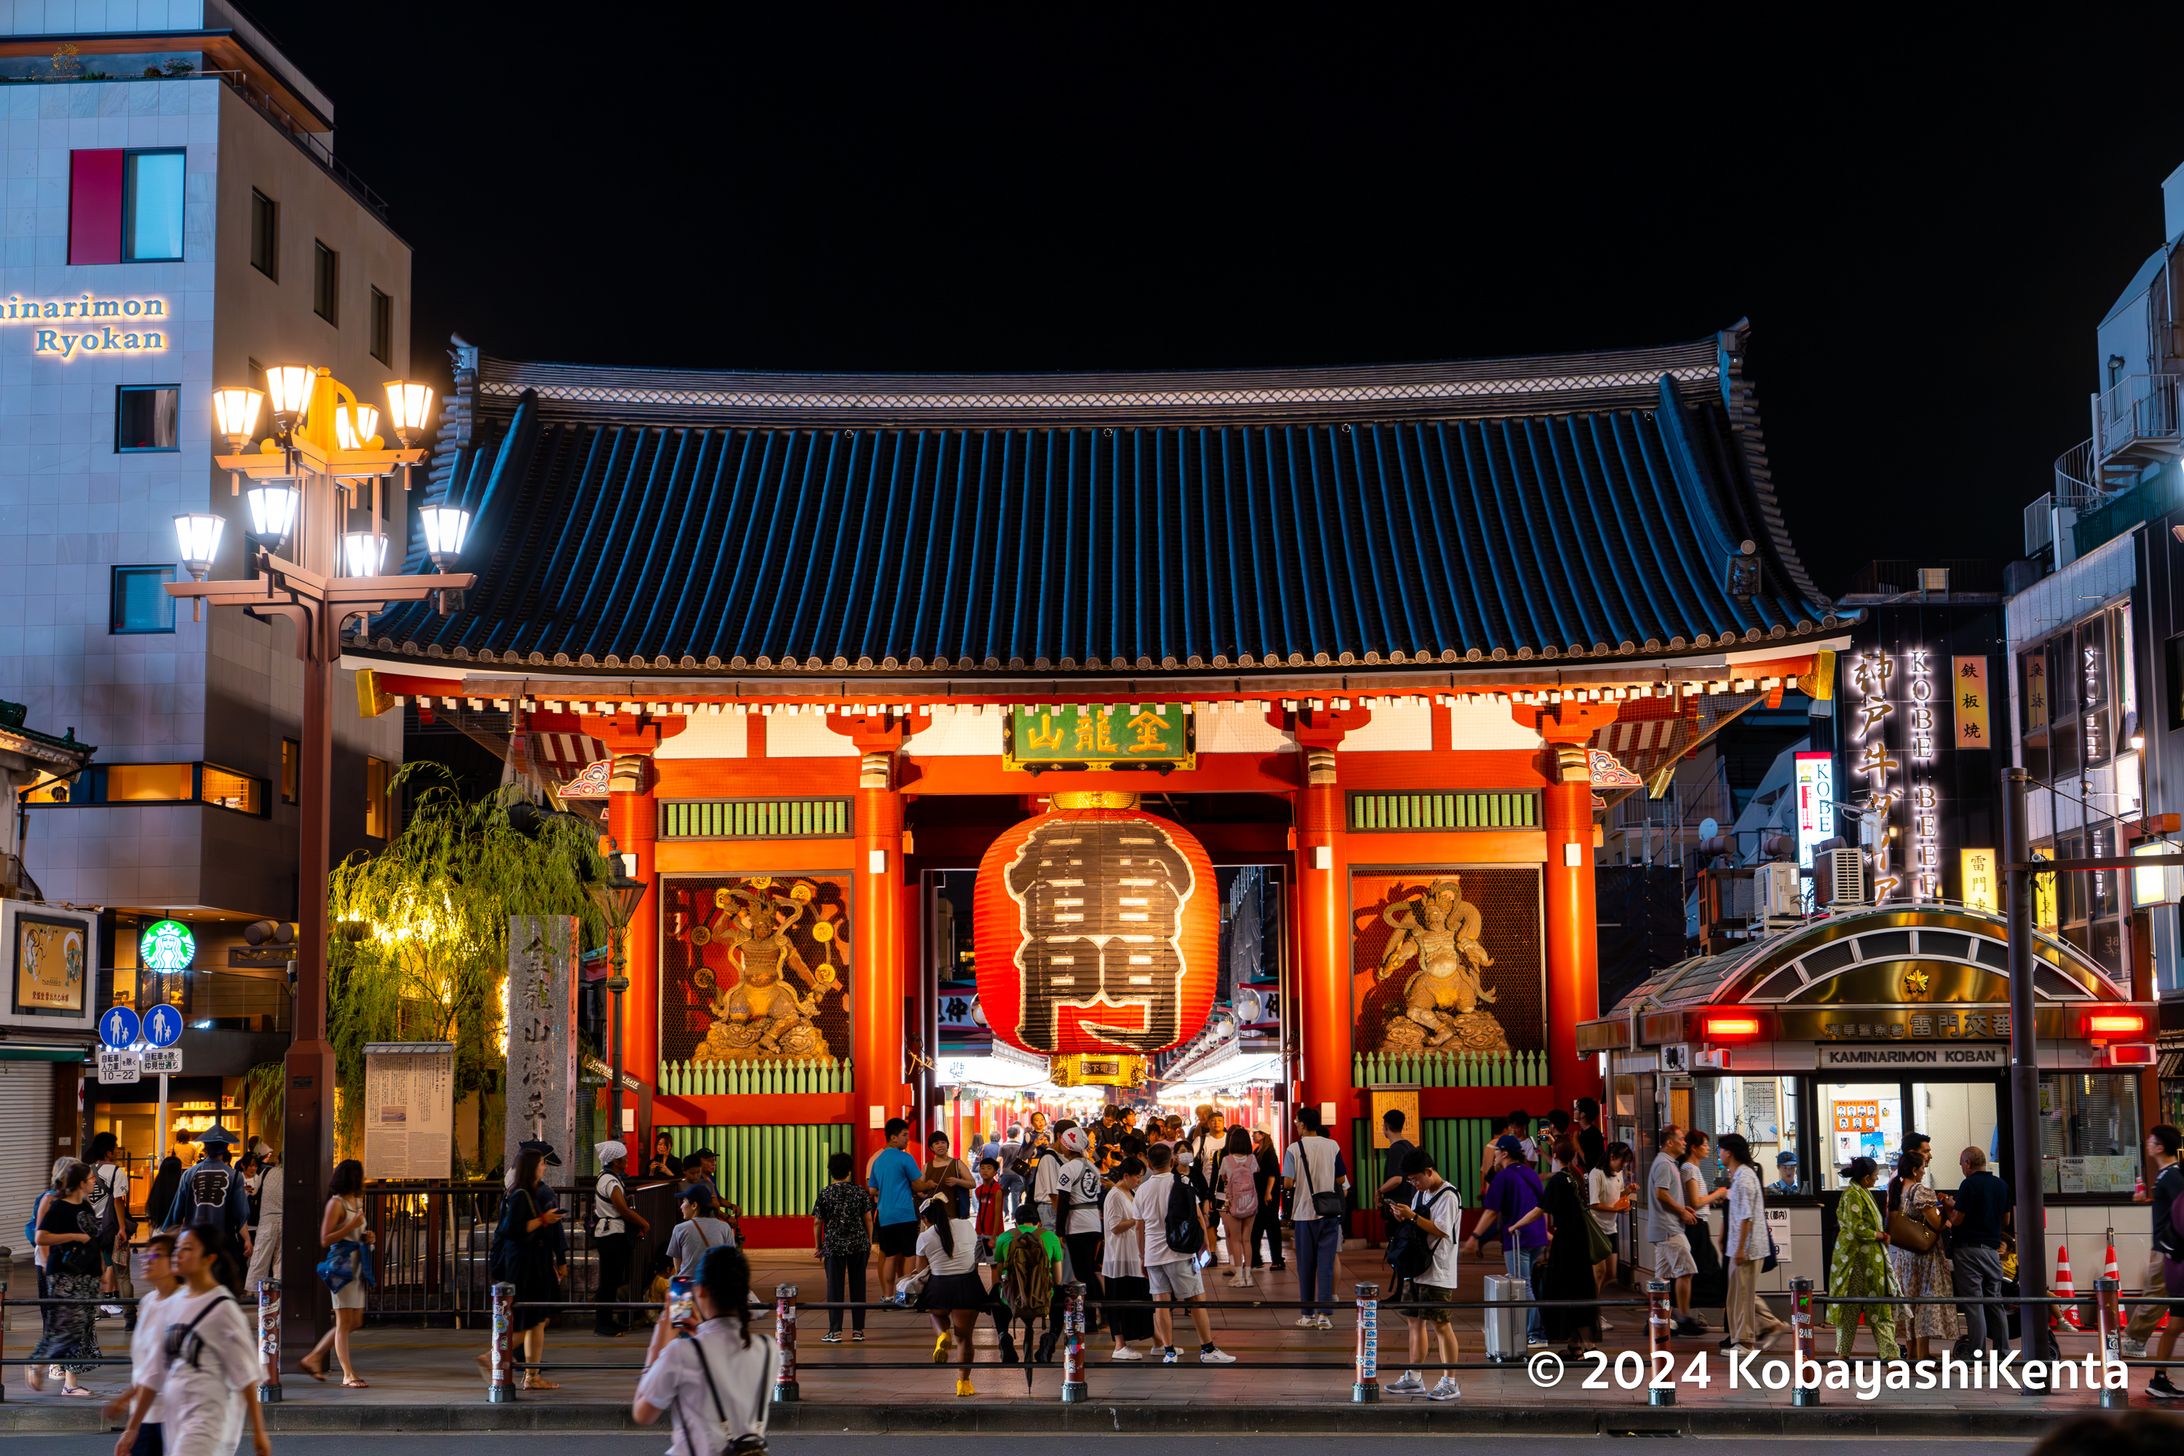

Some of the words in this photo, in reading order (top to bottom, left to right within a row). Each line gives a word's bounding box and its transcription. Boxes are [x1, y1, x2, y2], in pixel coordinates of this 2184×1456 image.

[35, 327, 163, 358] Ryokan
[1910, 651, 1934, 759] KOBE
[1960, 662, 1982, 739] 鉄板焼
[1816, 763, 1832, 833] KOBE
[1918, 787, 1938, 896] BEEF
[1003, 818, 1196, 1054] 雷門
[1910, 1014, 2011, 1037] 雷門交番
[101, 1054, 120, 1063] 自転車
[144, 1051, 179, 1061] 自転車を除く
[144, 1061, 179, 1071] 仲見世通り
[1829, 1051, 1937, 1064] KAMINARIMON
[1945, 1050, 1996, 1063] KOBAN
[192, 1169, 229, 1208] 雷
